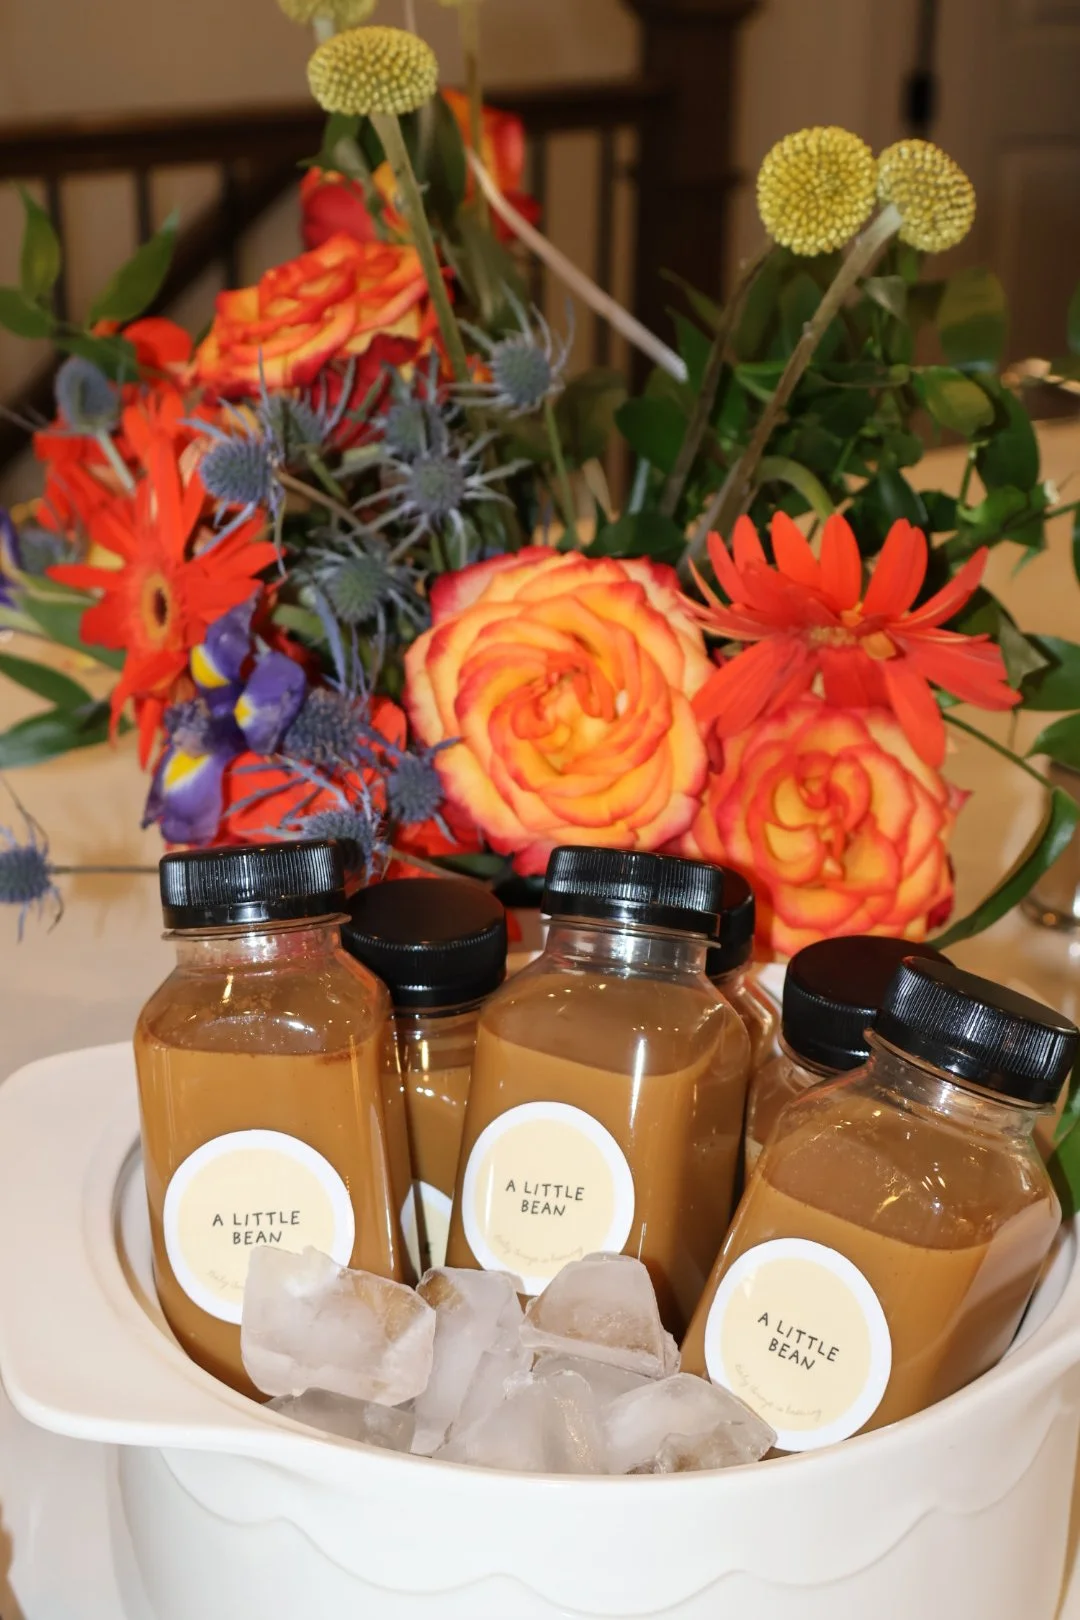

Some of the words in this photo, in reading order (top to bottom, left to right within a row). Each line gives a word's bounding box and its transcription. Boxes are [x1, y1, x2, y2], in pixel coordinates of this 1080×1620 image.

[505, 1179, 516, 1192] A
[524, 1181, 585, 1201] LITTLE
[520, 1199, 566, 1216] BEAN
[212, 1213, 224, 1227] A
[233, 1210, 301, 1226] LITTLE
[233, 1230, 282, 1245] BEAN
[757, 1312, 769, 1327] A
[776, 1320, 840, 1362] LITTLE
[768, 1337, 816, 1371] BEAN
